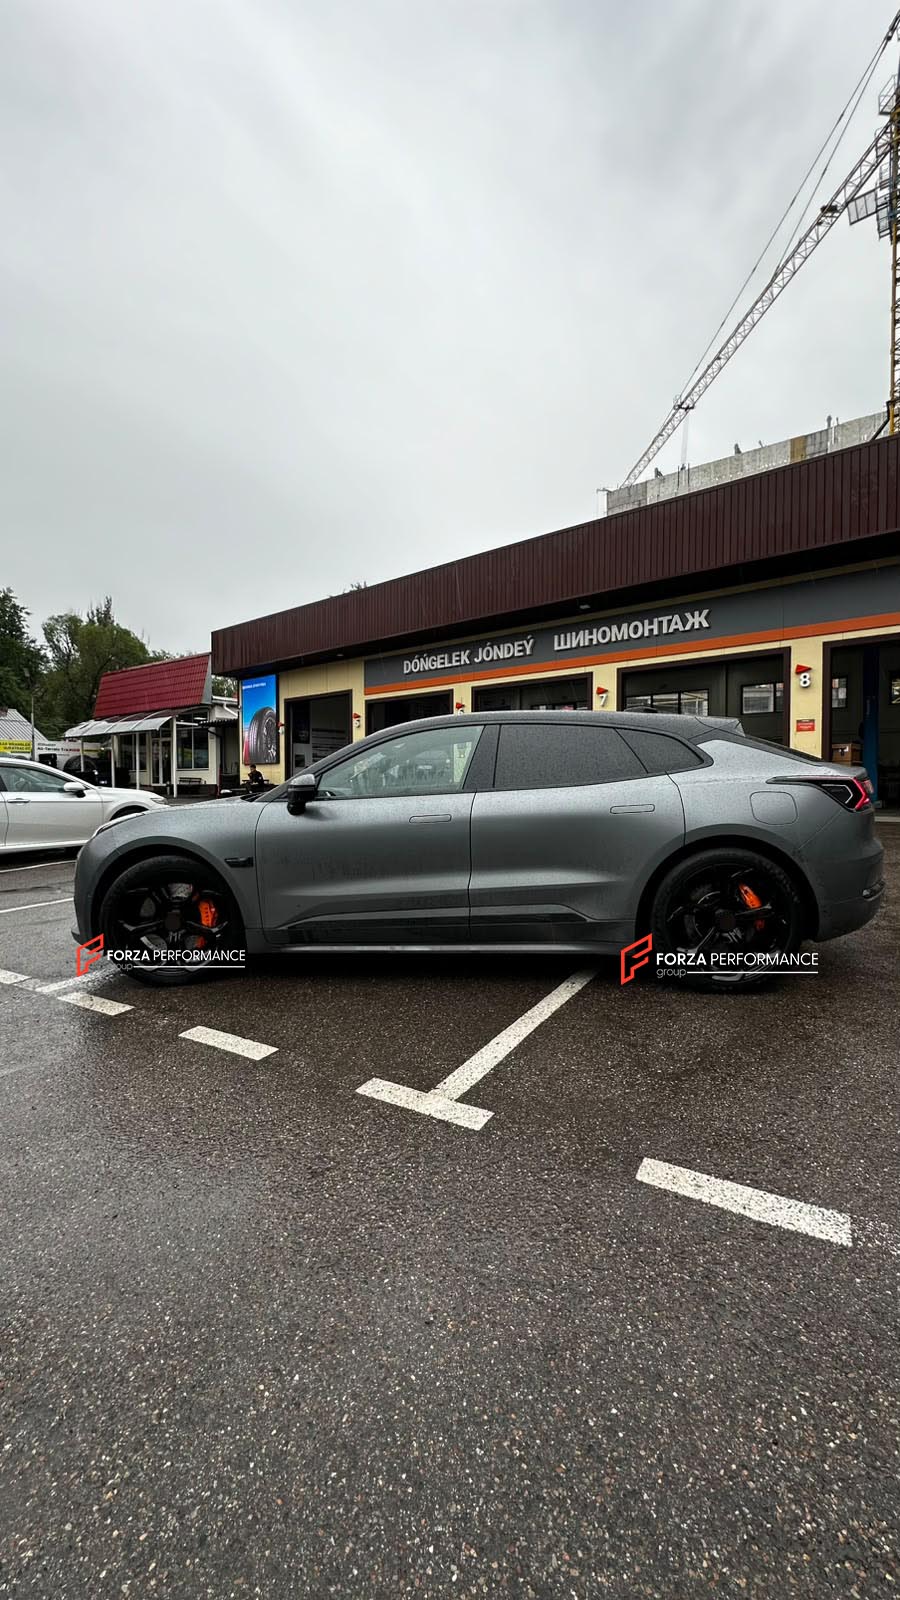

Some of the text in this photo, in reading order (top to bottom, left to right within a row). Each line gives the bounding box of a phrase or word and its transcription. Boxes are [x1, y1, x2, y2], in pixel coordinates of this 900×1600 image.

[553, 609, 710, 650] ШИНОМОНТАЖ
[800, 672, 811, 688] 8
[599, 692, 608, 706] 7
